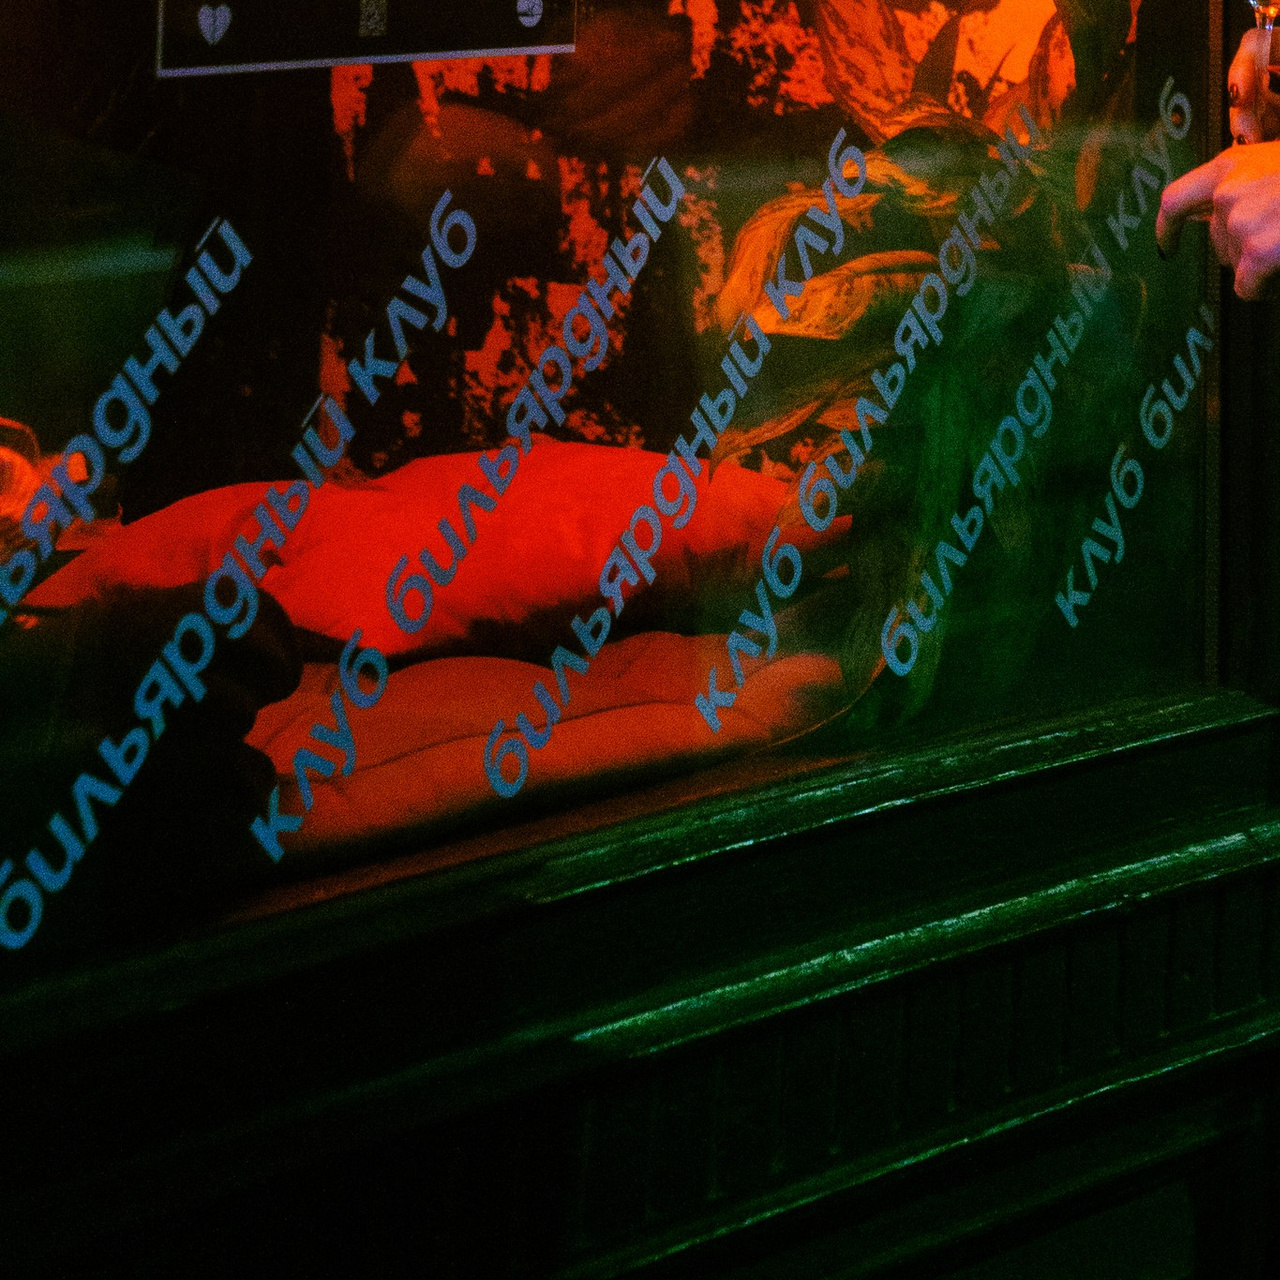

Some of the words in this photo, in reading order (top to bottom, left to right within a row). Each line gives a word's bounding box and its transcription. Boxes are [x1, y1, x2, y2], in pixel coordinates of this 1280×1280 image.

[0, 217, 254, 626] ьярдный
[0, 393, 357, 949] бильярдный
[348, 190, 477, 404] клуб
[250, 629, 389, 861] клуб
[385, 156, 686, 635] бильярдный
[484, 313, 771, 798] бильярдный
[764, 128, 869, 321] клуб
[695, 527, 802, 733] клуб
[799, 104, 1040, 532] бильярдный
[881, 244, 1111, 677] бильярдный
[1106, 77, 1191, 251] клуб
[1055, 442, 1144, 629] клуб
